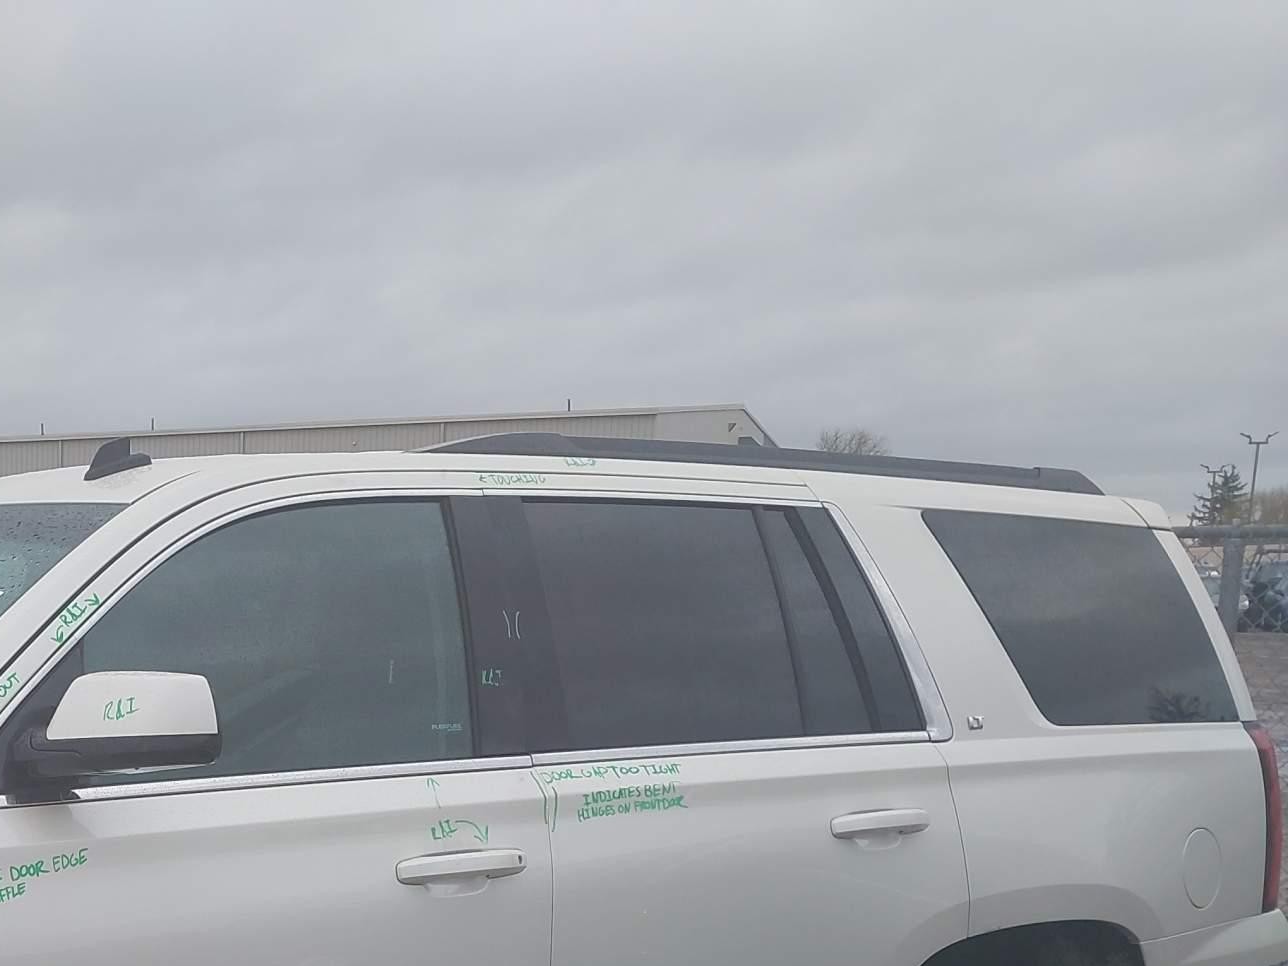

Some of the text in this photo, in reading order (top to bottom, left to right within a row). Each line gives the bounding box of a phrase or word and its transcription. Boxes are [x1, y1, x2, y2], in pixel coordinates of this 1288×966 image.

[606, 765, 640, 779] TOO
[638, 763, 682, 776] TIGHT
[582, 780, 681, 806] INDICATES BENT
[577, 803, 617, 822] HINGES
[617, 800, 632, 815] ON
[9, 860, 50, 882] DOOR
[52, 847, 89, 873] EDGE
